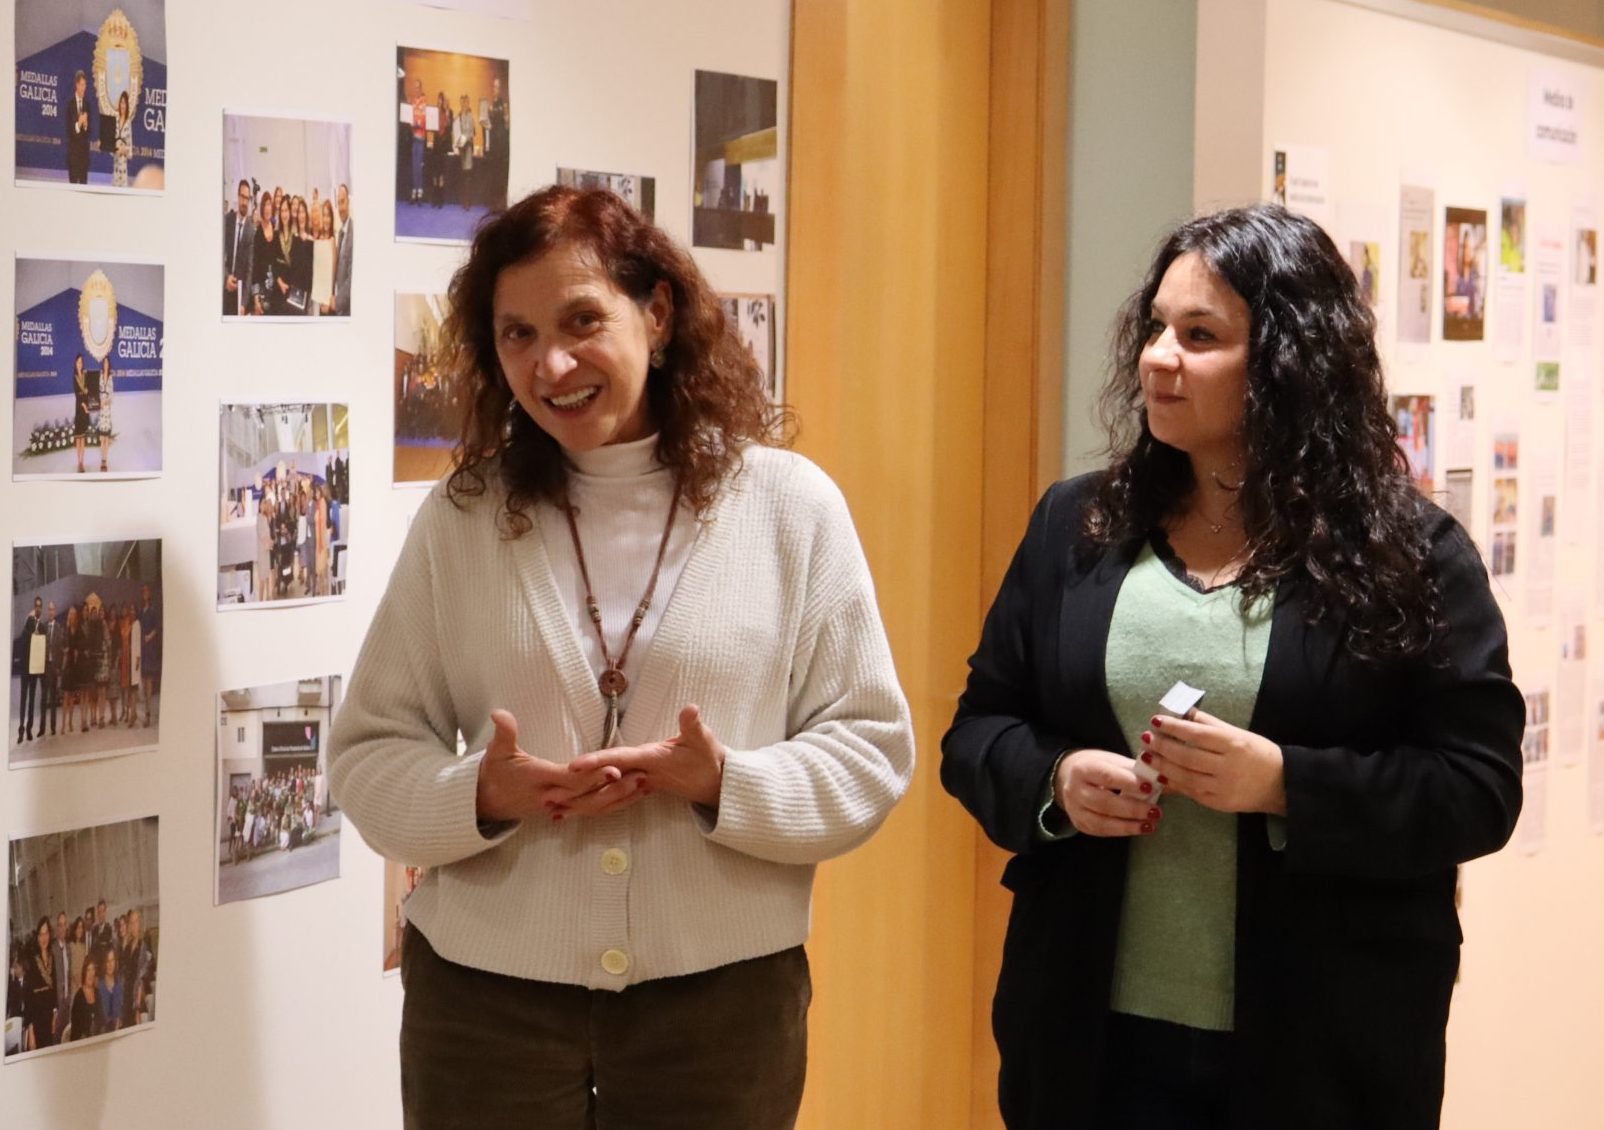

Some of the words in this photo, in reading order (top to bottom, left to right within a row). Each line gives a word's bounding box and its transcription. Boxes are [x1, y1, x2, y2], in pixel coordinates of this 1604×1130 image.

[20, 70, 58, 87] MEDALLAS
[20, 84, 58, 103] GALICIA
[41, 104, 58, 117] 2014
[21, 320, 53, 333] MEDALLAS
[118, 325, 156, 341] MEDALLAS
[21, 331, 54, 346] GALICIA
[117, 339, 157, 360] GALICIA
